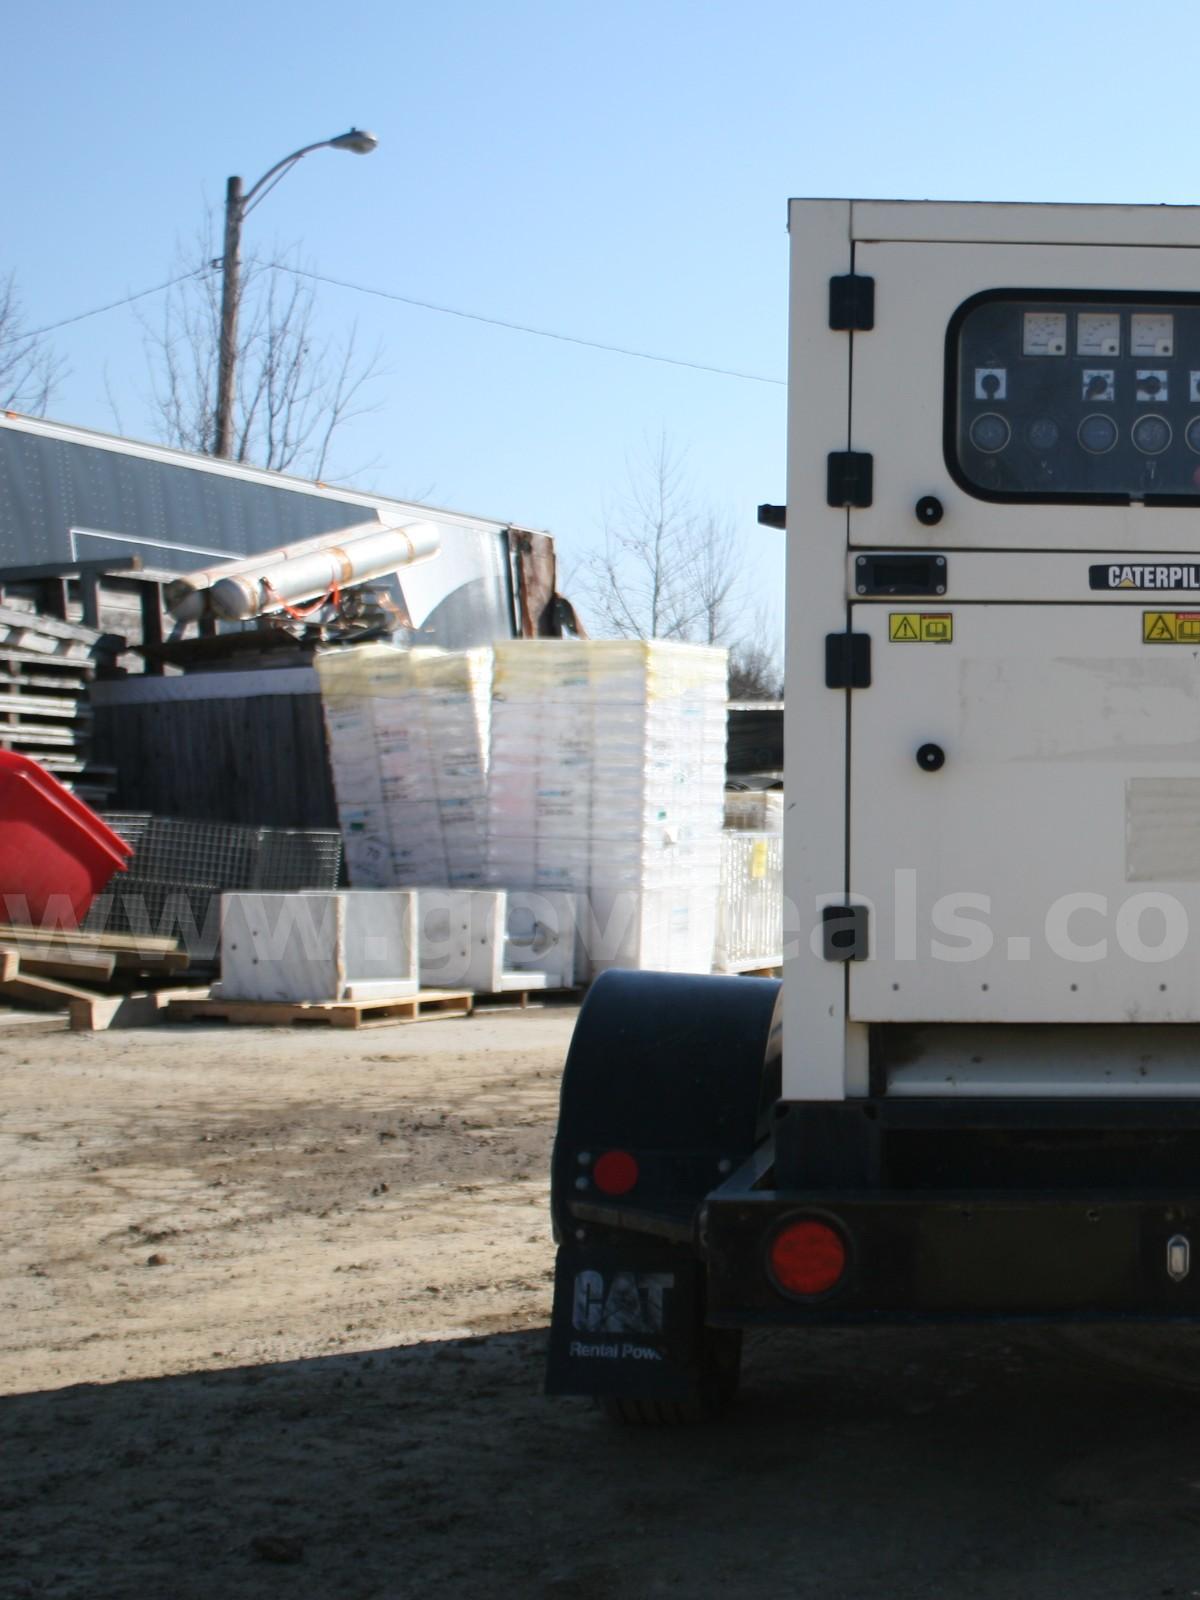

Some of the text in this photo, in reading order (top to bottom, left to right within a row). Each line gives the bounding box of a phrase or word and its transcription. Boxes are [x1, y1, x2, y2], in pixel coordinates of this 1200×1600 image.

[573, 1269, 675, 1333] CAT
[570, 1341, 664, 1360] Rental Pow
